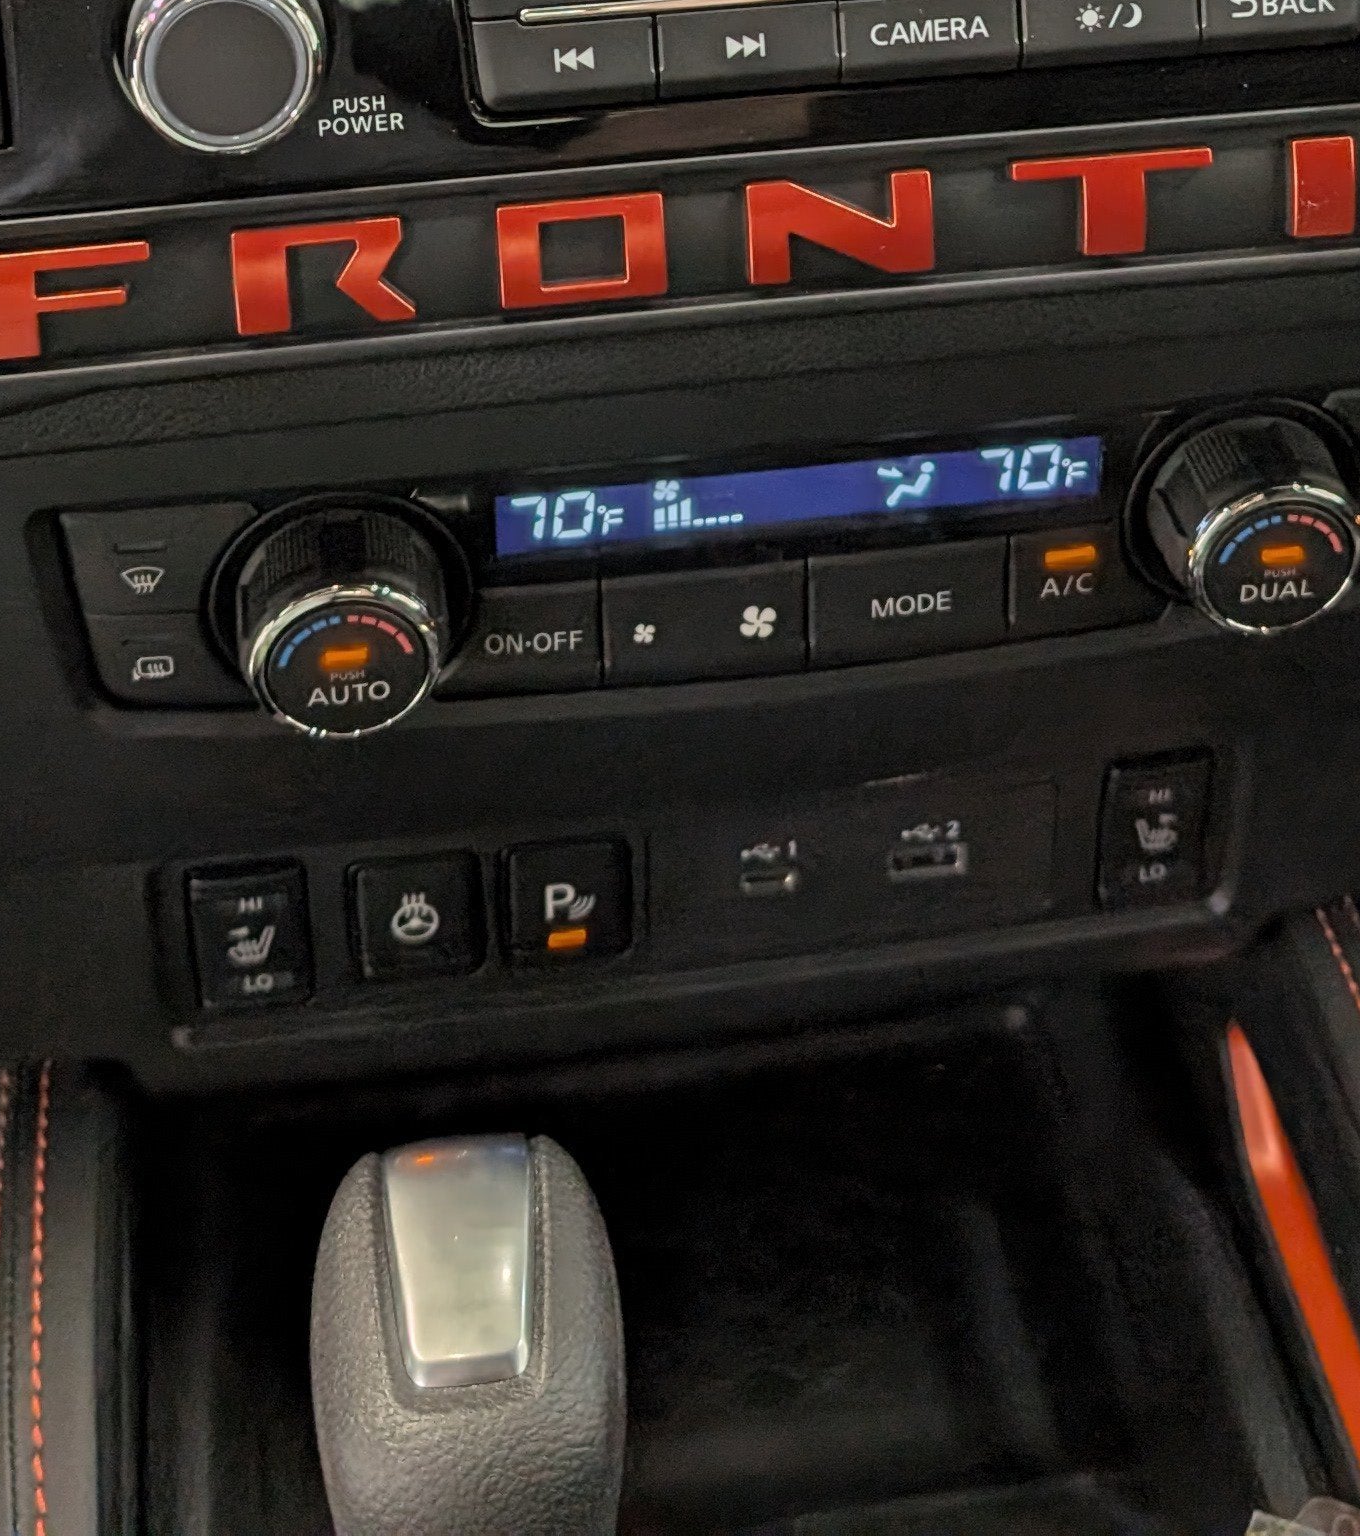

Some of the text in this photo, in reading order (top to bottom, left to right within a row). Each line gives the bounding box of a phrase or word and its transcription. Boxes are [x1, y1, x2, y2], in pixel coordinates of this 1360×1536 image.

[870, 16, 989, 46] CAMERA
[332, 95, 386, 115] PUSH
[318, 113, 404, 138] POWER
[1040, 571, 1094, 599] A/C
[1240, 579, 1315, 603] DUAL
[871, 589, 952, 619] MODE
[307, 680, 391, 707] AUTO
[243, 974, 274, 993] LO
